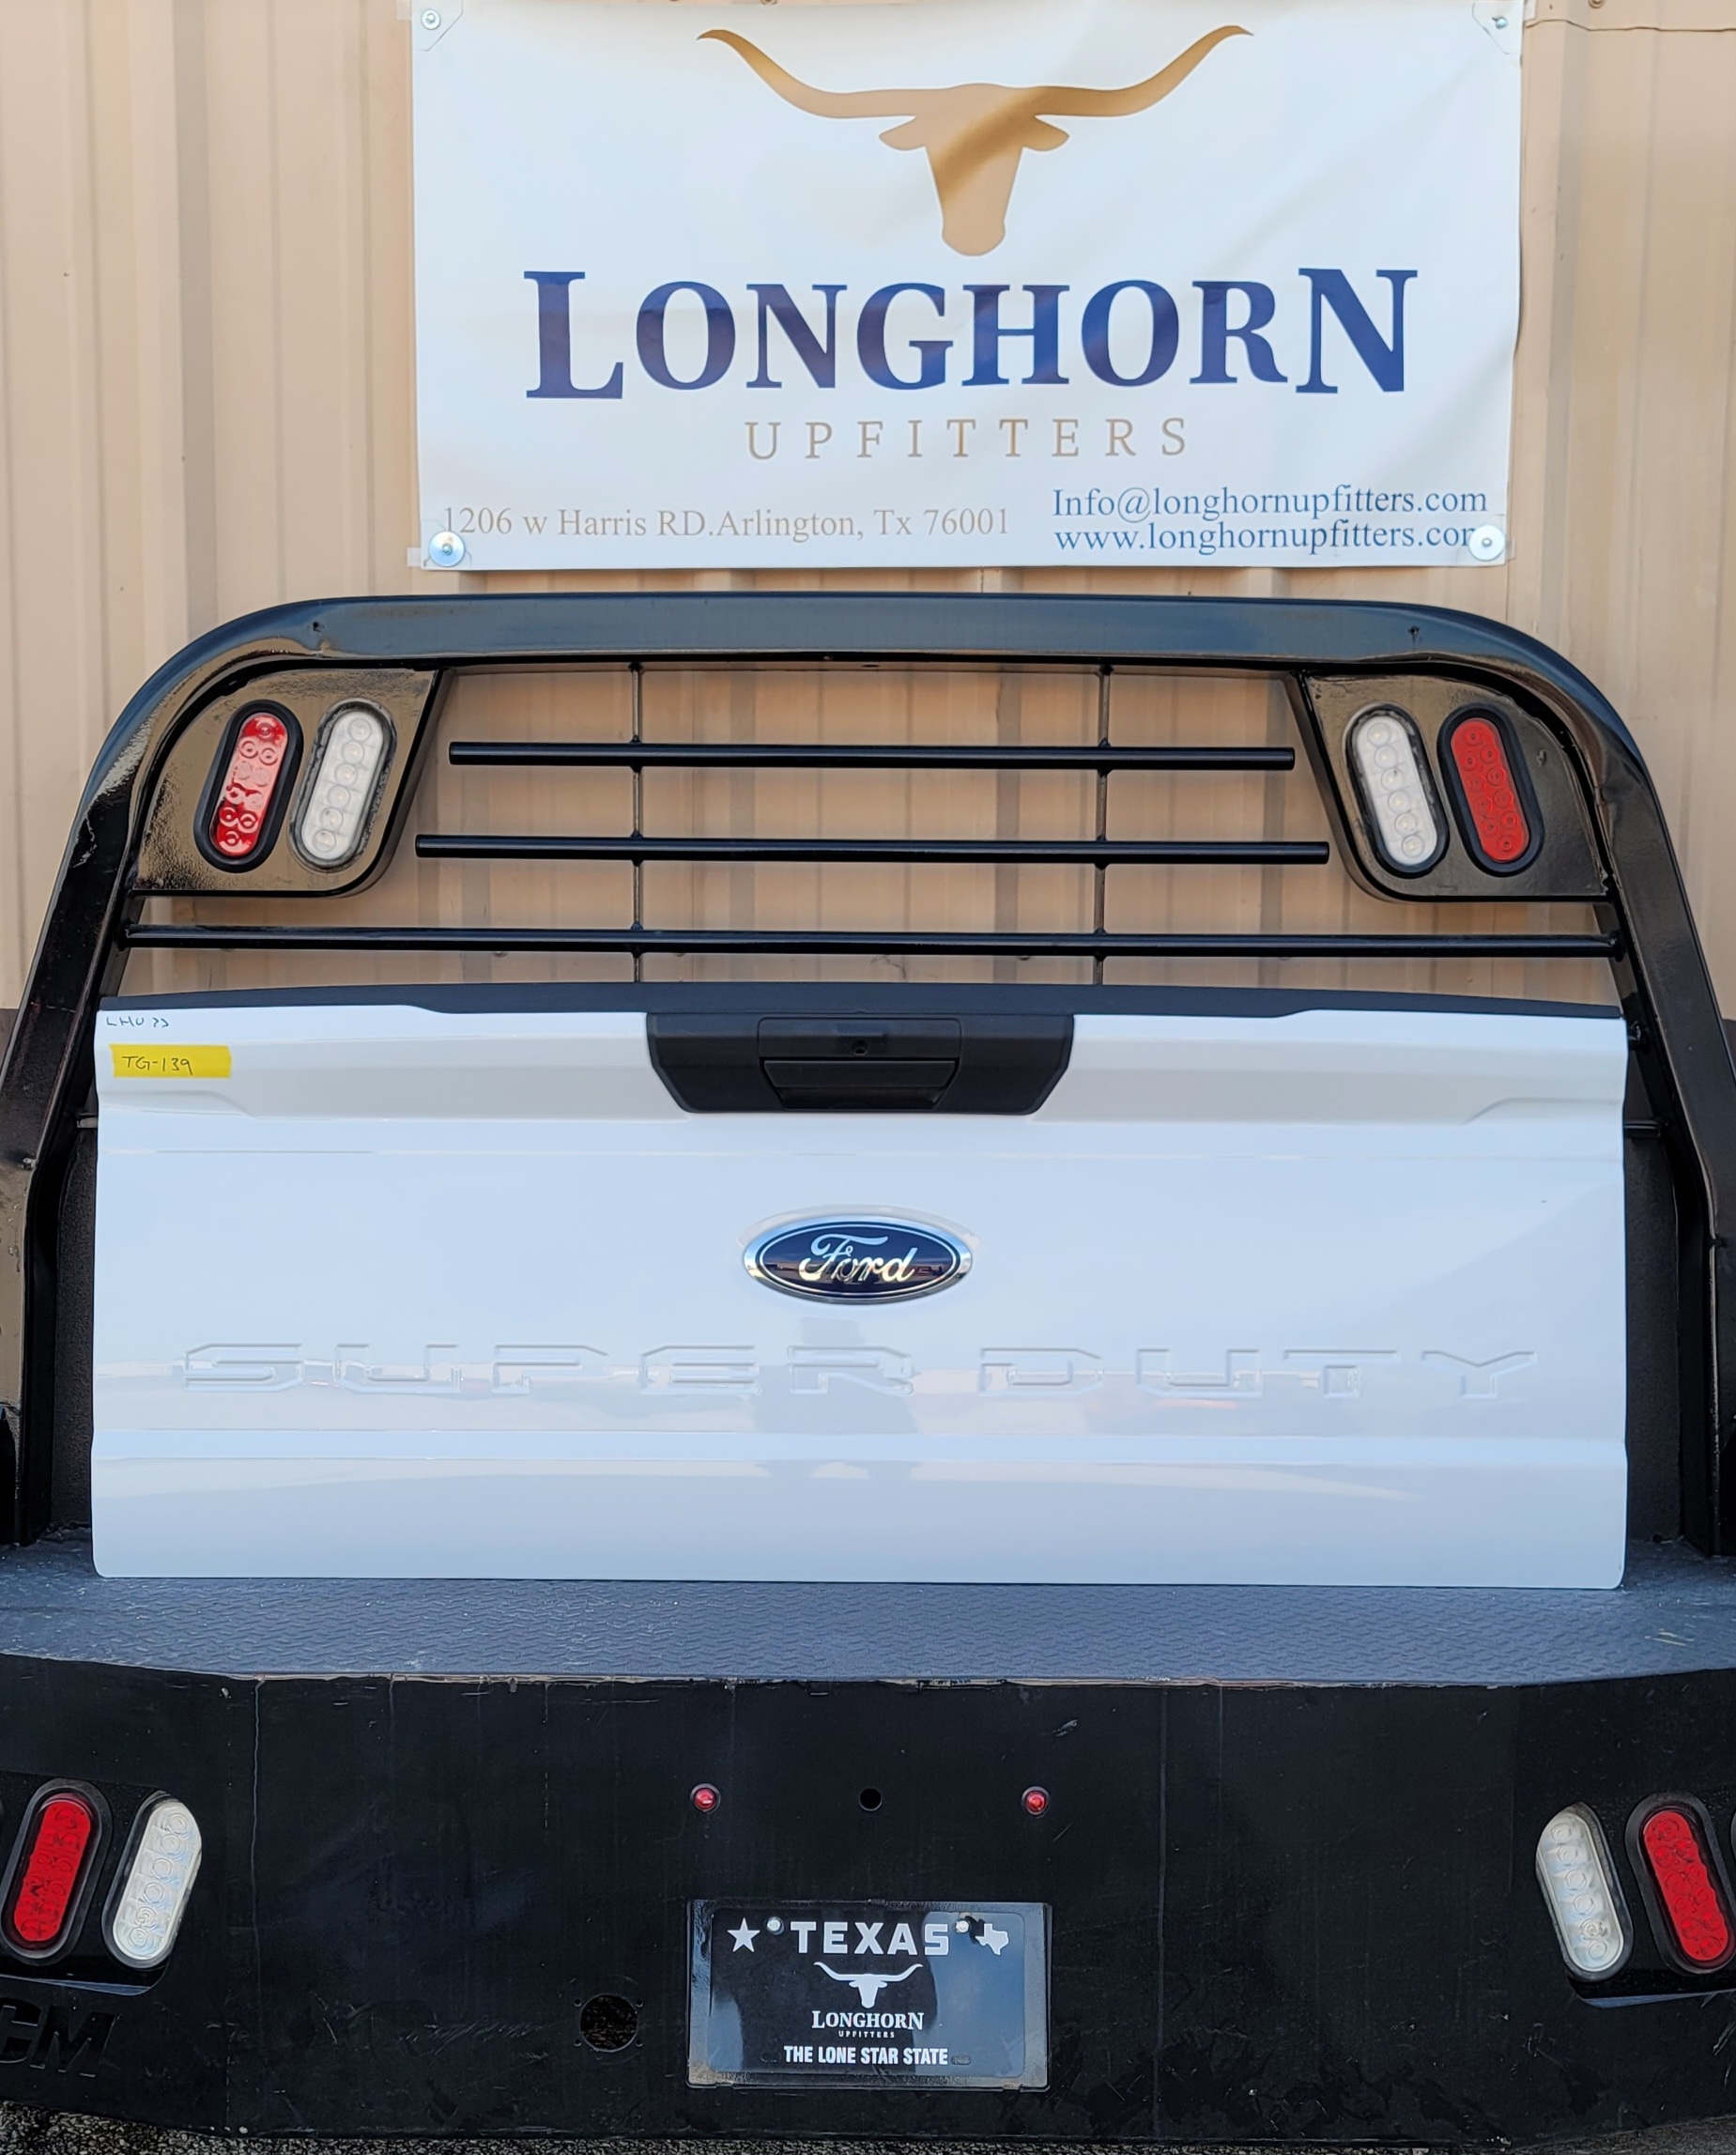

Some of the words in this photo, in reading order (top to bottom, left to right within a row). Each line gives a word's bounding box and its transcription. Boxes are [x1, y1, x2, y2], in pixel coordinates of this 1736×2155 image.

[523, 267, 1418, 400] LONGHORN
[745, 417, 1186, 460] UPFITTERS
[443, 506, 513, 535] 1206
[522, 515, 548, 535] w
[557, 508, 648, 536] Harris
[873, 509, 914, 536] Tx
[923, 507, 1008, 535] 76001
[1052, 484, 1488, 523] Info@longhornupfitters.com
[121, 1054, 194, 1076] TG-139
[798, 1233, 918, 1283] Ford
[183, 1343, 916, 1396] SUPER
[977, 1347, 1539, 1399] DUTY
[790, 1920, 950, 1957] TEXAS
[811, 2009, 925, 2031] LONGHORN
[837, 2030, 896, 2039] UPFITTERS
[783, 2045, 814, 2064] THE
[818, 2045, 856, 2065] LONE
[860, 2046, 899, 2066] STAR
[902, 2047, 948, 2066] STATE
